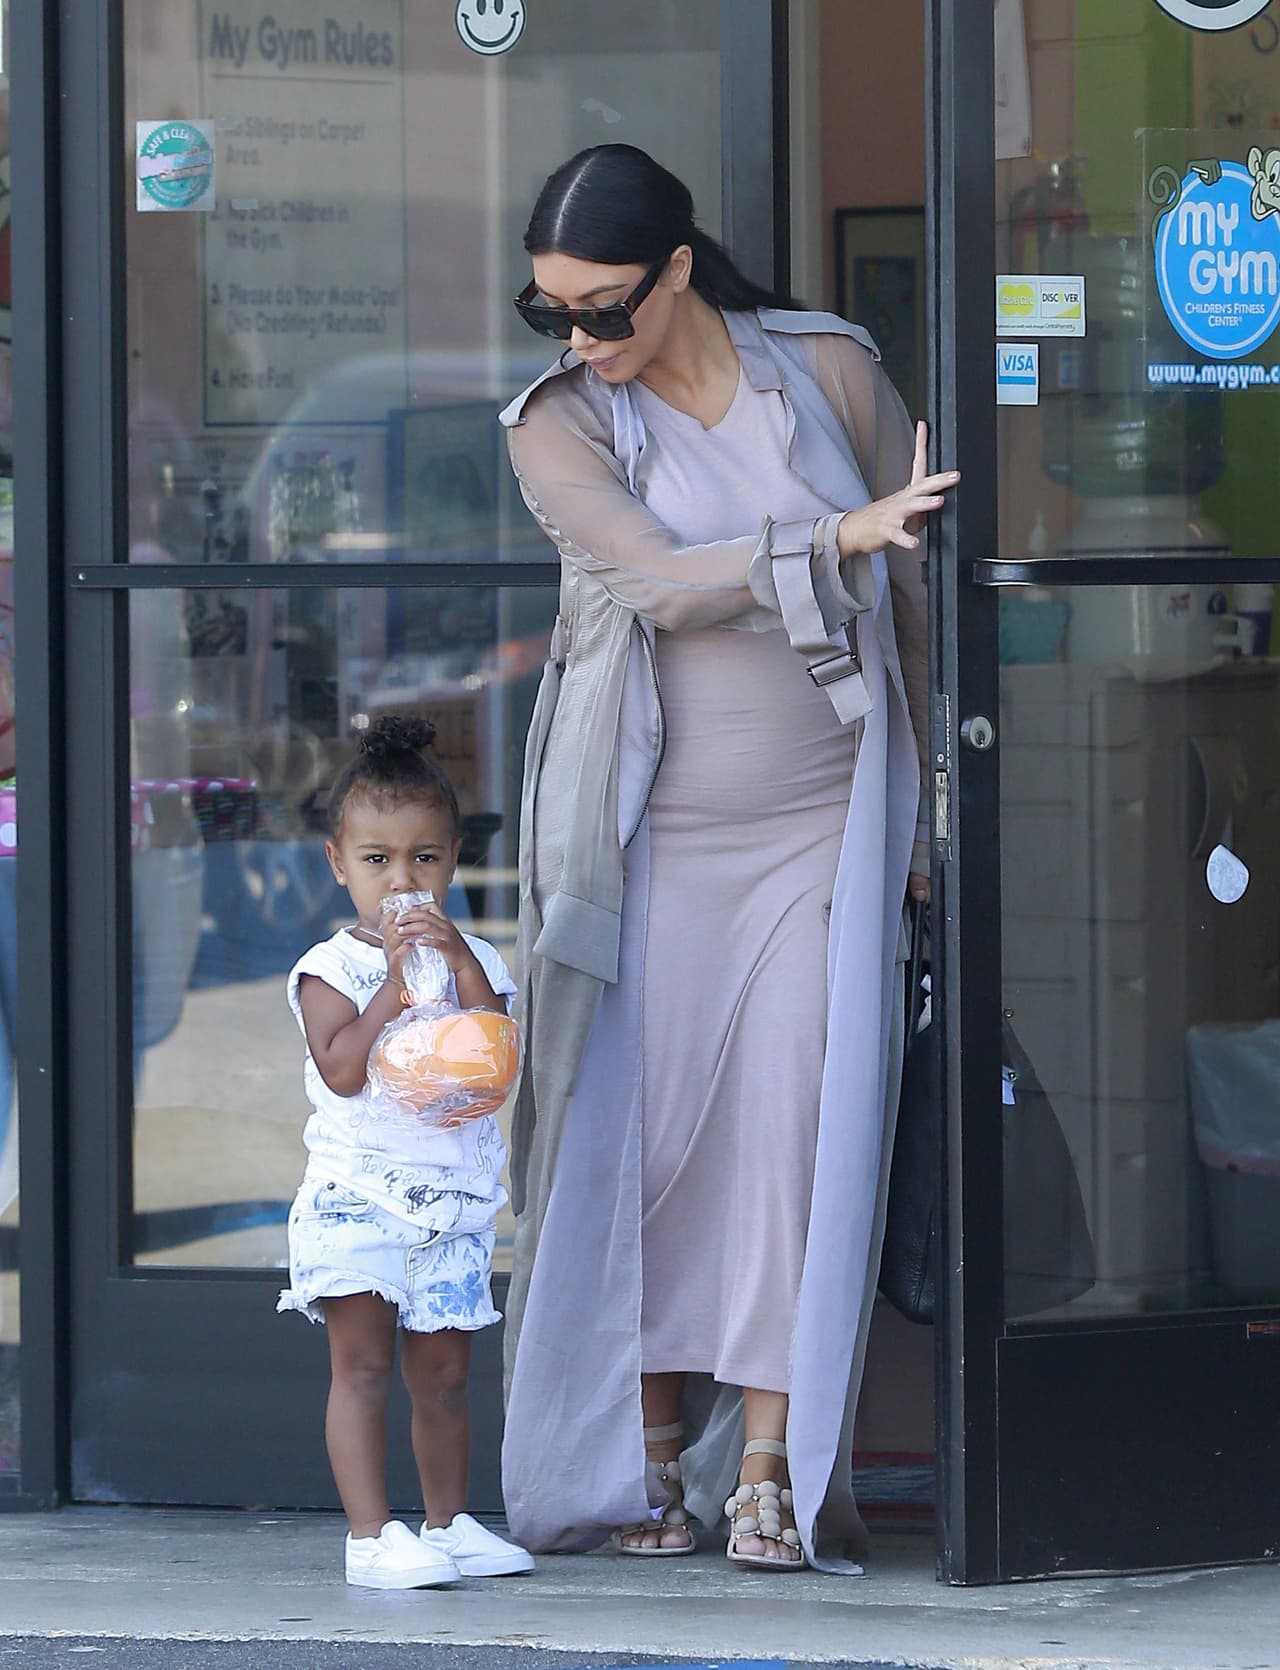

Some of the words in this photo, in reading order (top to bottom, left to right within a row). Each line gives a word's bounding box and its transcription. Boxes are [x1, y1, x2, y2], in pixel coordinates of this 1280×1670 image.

[208, 12, 251, 69] My
[257, 14, 318, 71] Gym
[324, 17, 395, 66] Rules
[317, 118, 367, 145] Carpet
[1178, 201, 1239, 247] MY
[1188, 250, 1277, 296] GYM
[227, 283, 273, 305] Please
[275, 285, 294, 305] do
[295, 284, 326, 306] Your
[1042, 293, 1078, 302] DISCOVER
[1003, 355, 1034, 371] VISA
[211, 366, 225, 388] 4.
